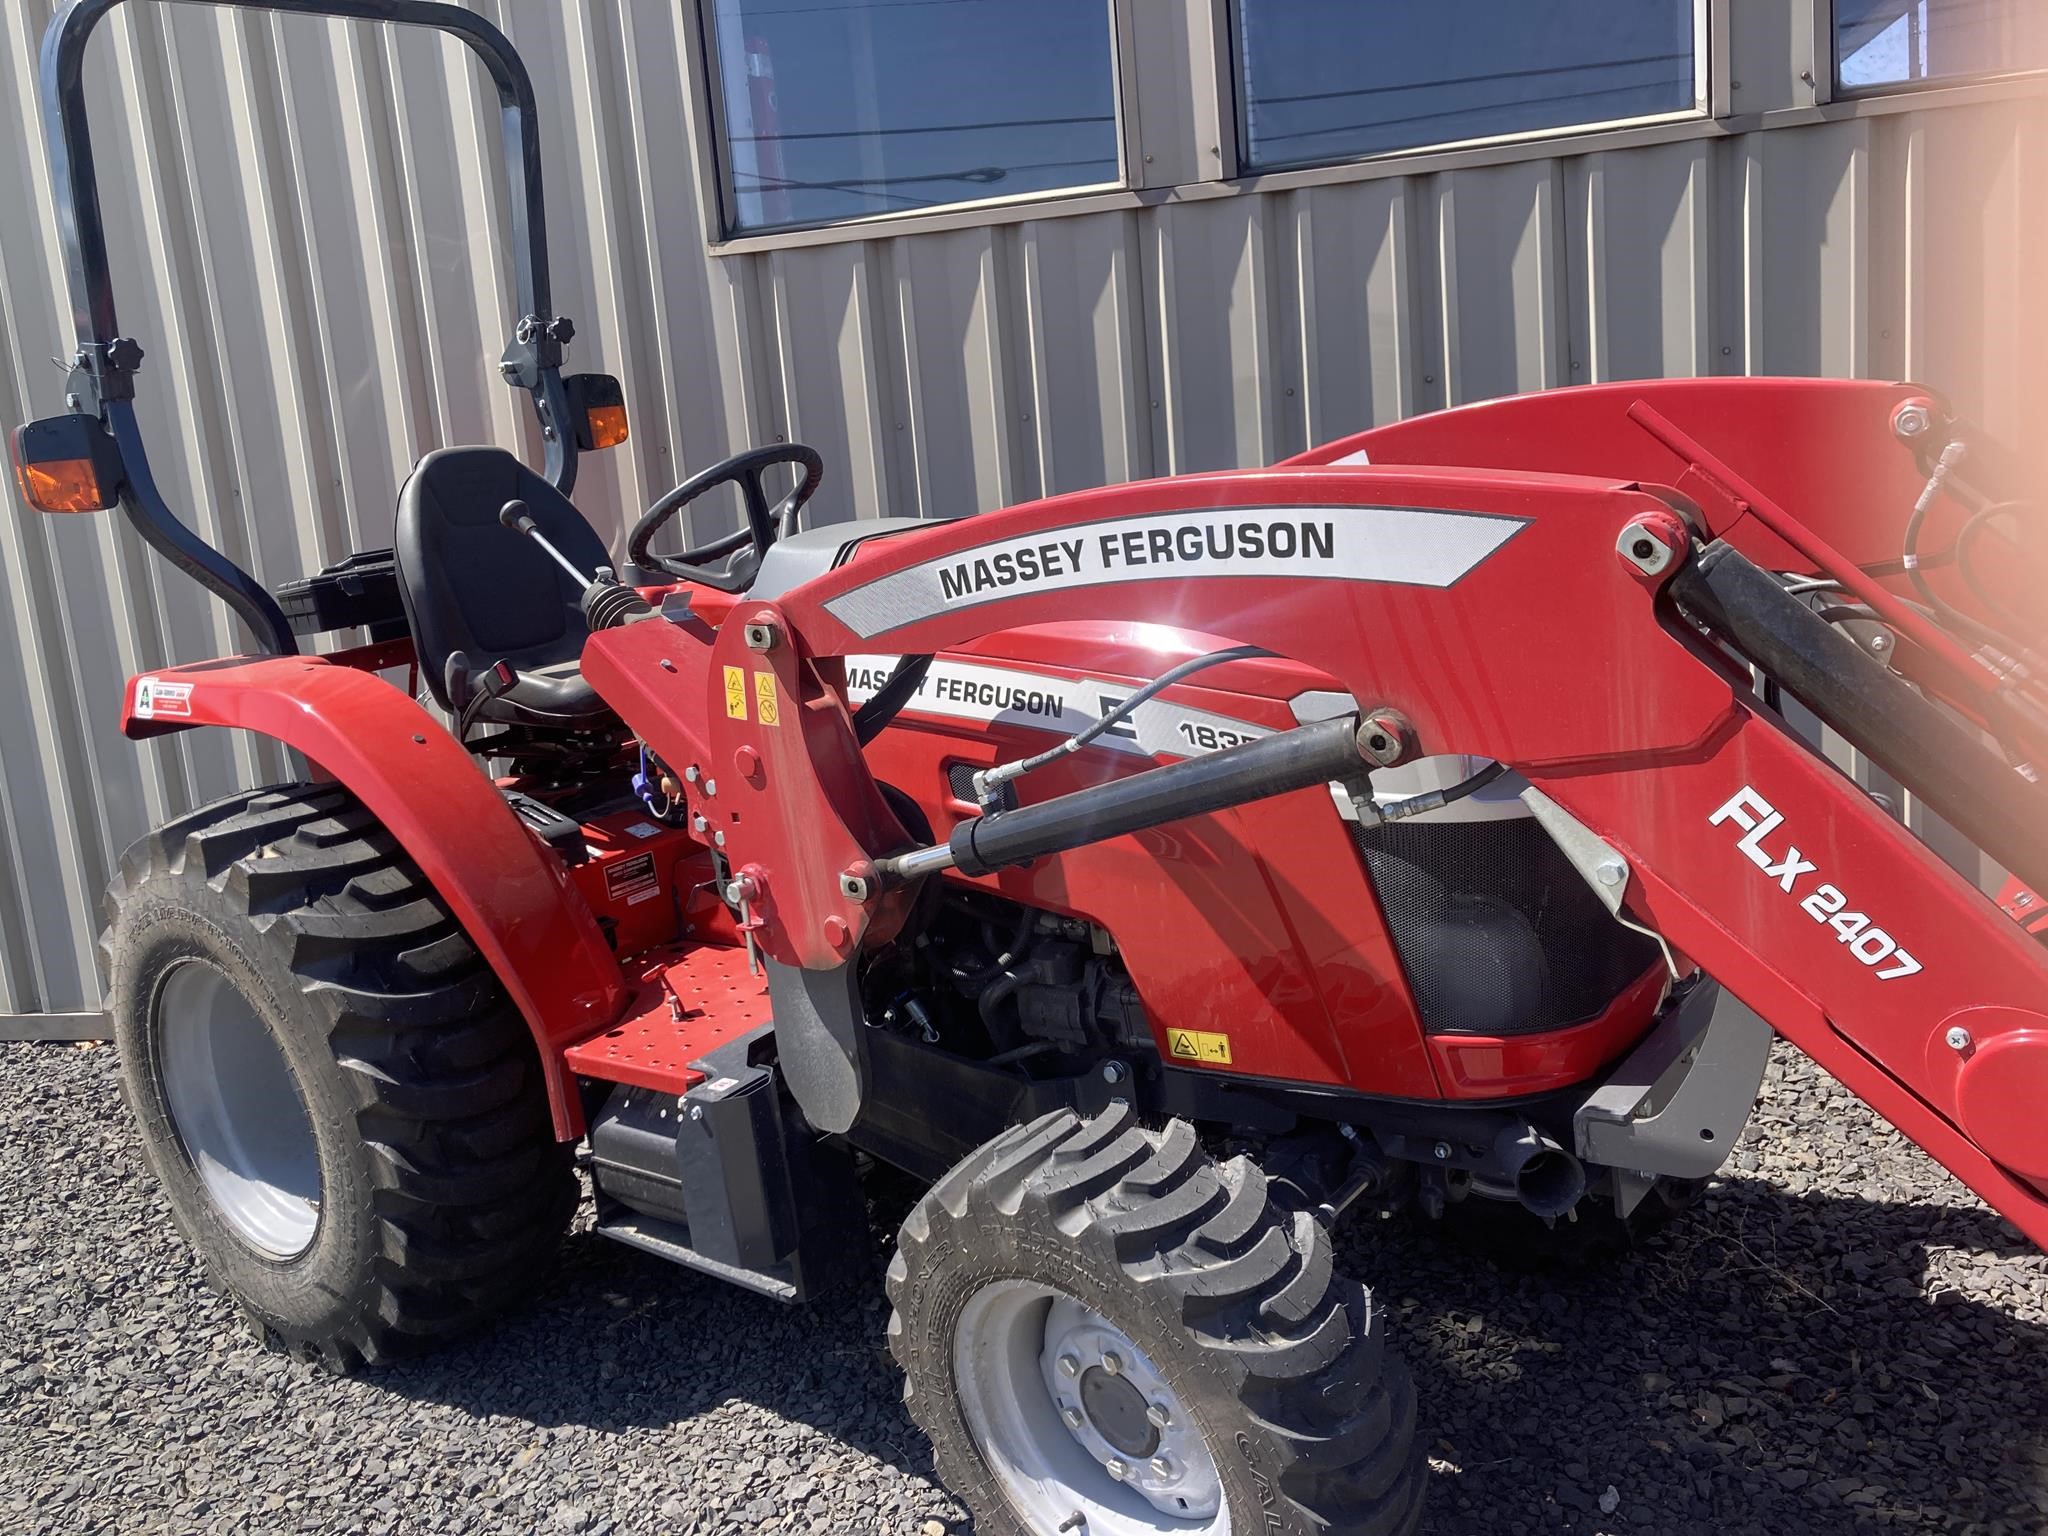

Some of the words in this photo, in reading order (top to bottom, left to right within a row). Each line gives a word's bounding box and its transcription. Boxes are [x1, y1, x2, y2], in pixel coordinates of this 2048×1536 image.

[939, 538, 1084, 600] MASSEY
[1098, 521, 1334, 569] FERGUSON
[936, 676, 1063, 719] FERGUSON
[1179, 723, 1258, 750] 183
[1707, 784, 1819, 895] FLX
[1798, 882, 1925, 981] 2407
